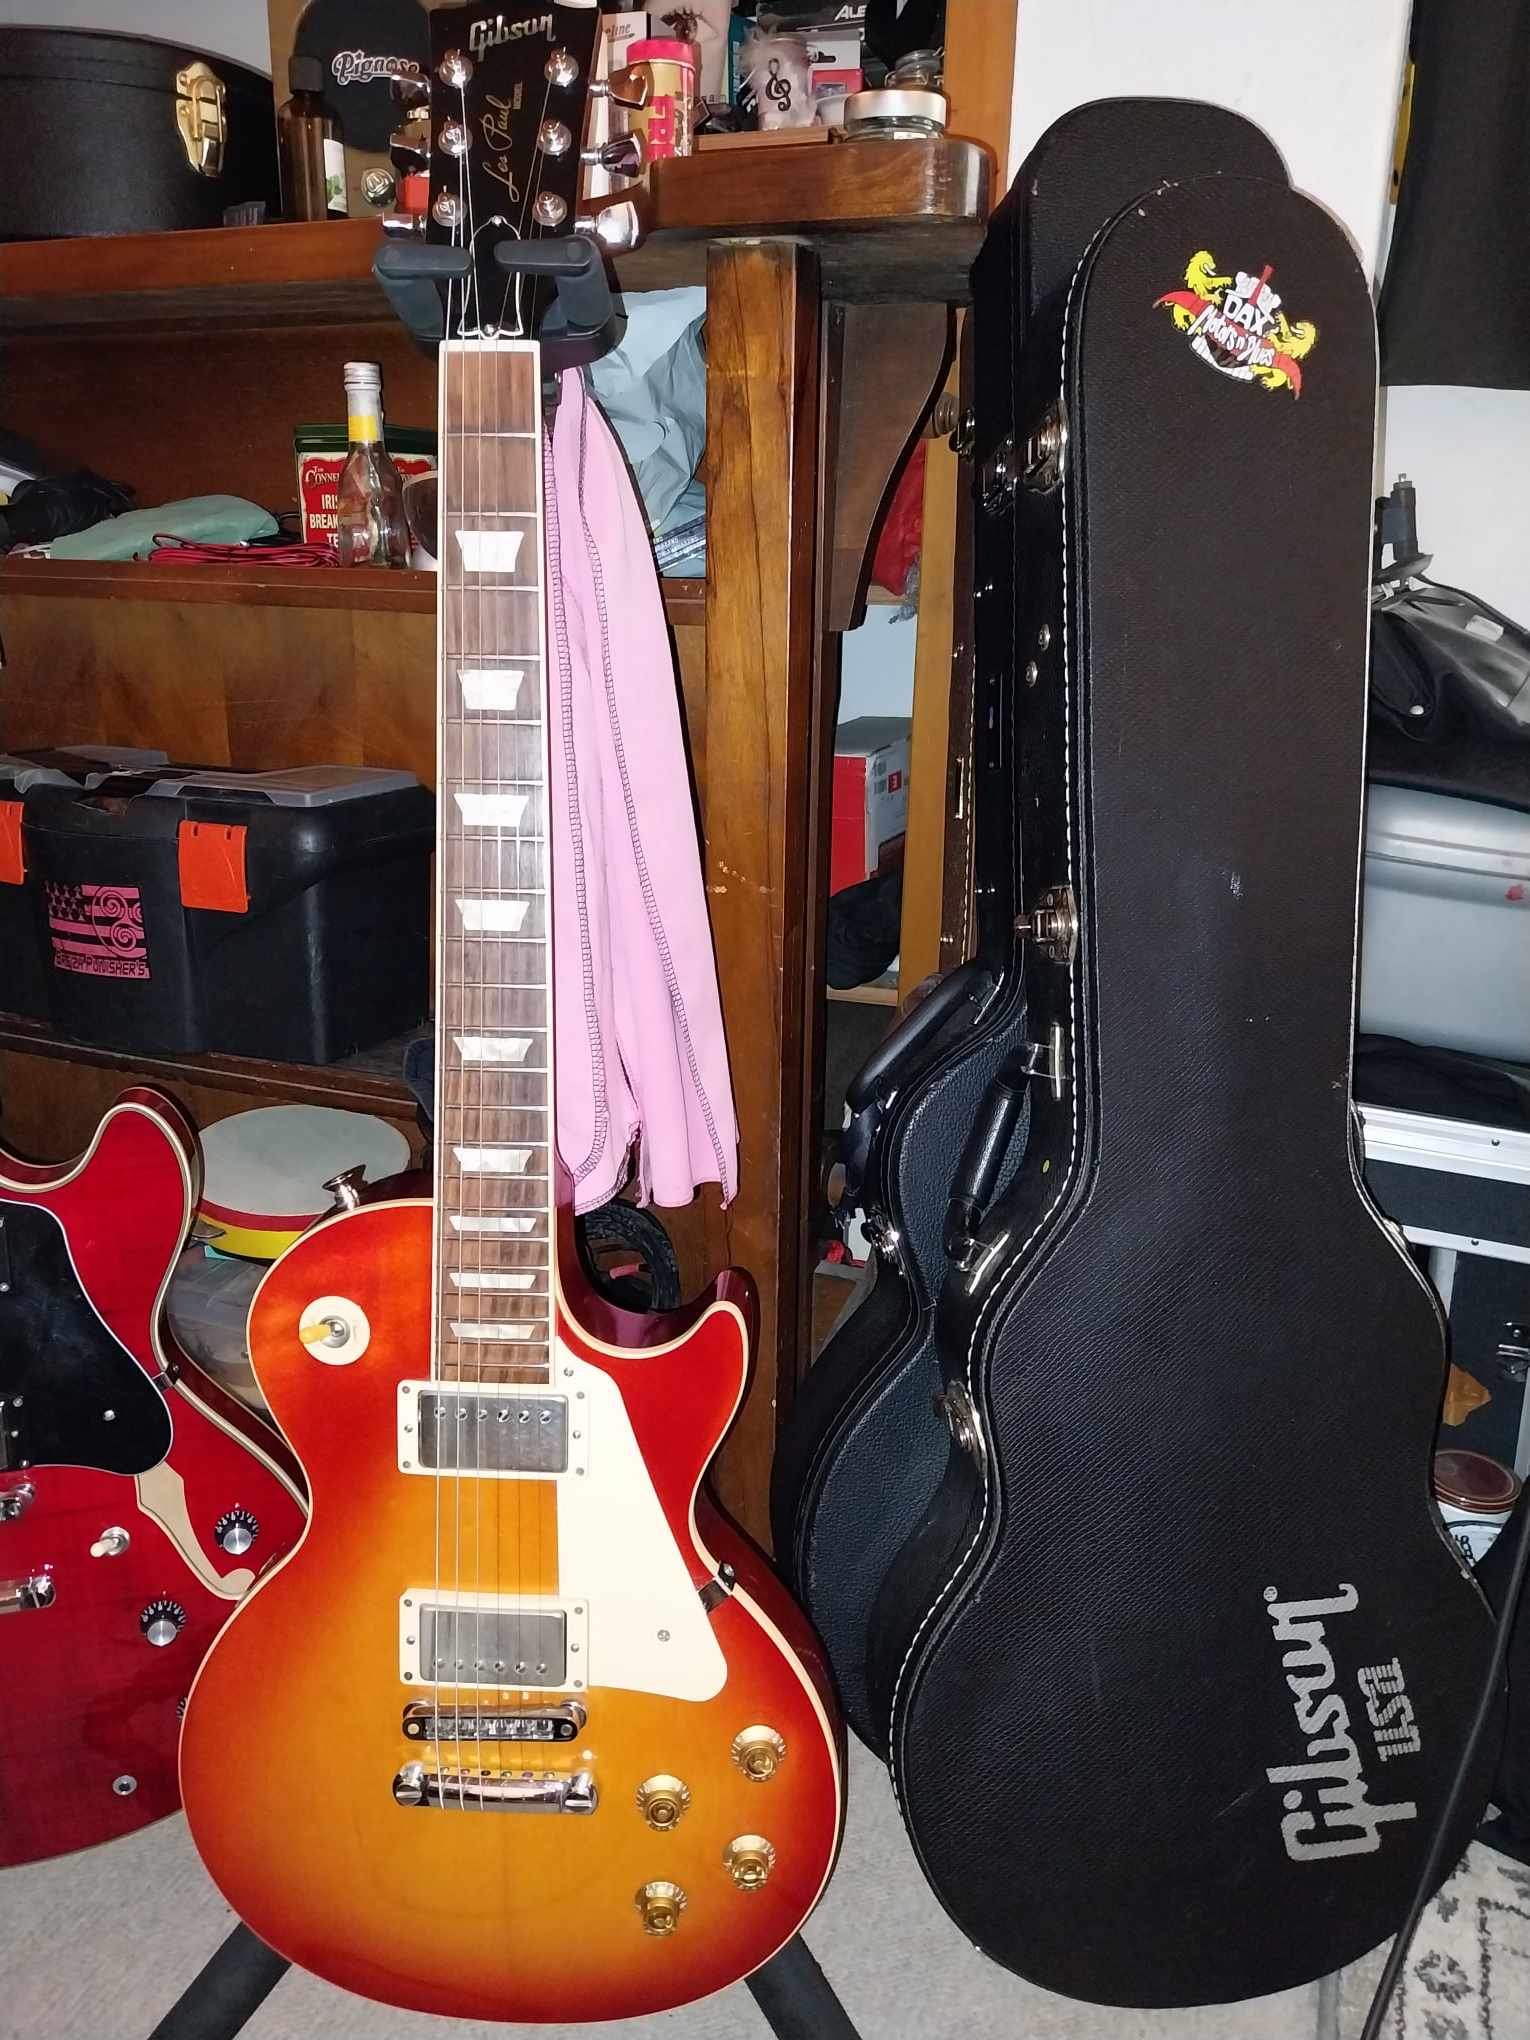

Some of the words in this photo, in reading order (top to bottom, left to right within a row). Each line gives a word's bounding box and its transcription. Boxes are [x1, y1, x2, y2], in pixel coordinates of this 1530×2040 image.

[469, 14, 556, 62] Gibson
[480, 94, 513, 151] Paul
[1265, 1582, 1418, 1862] Gibson
[1357, 1656, 1422, 1762] USA
